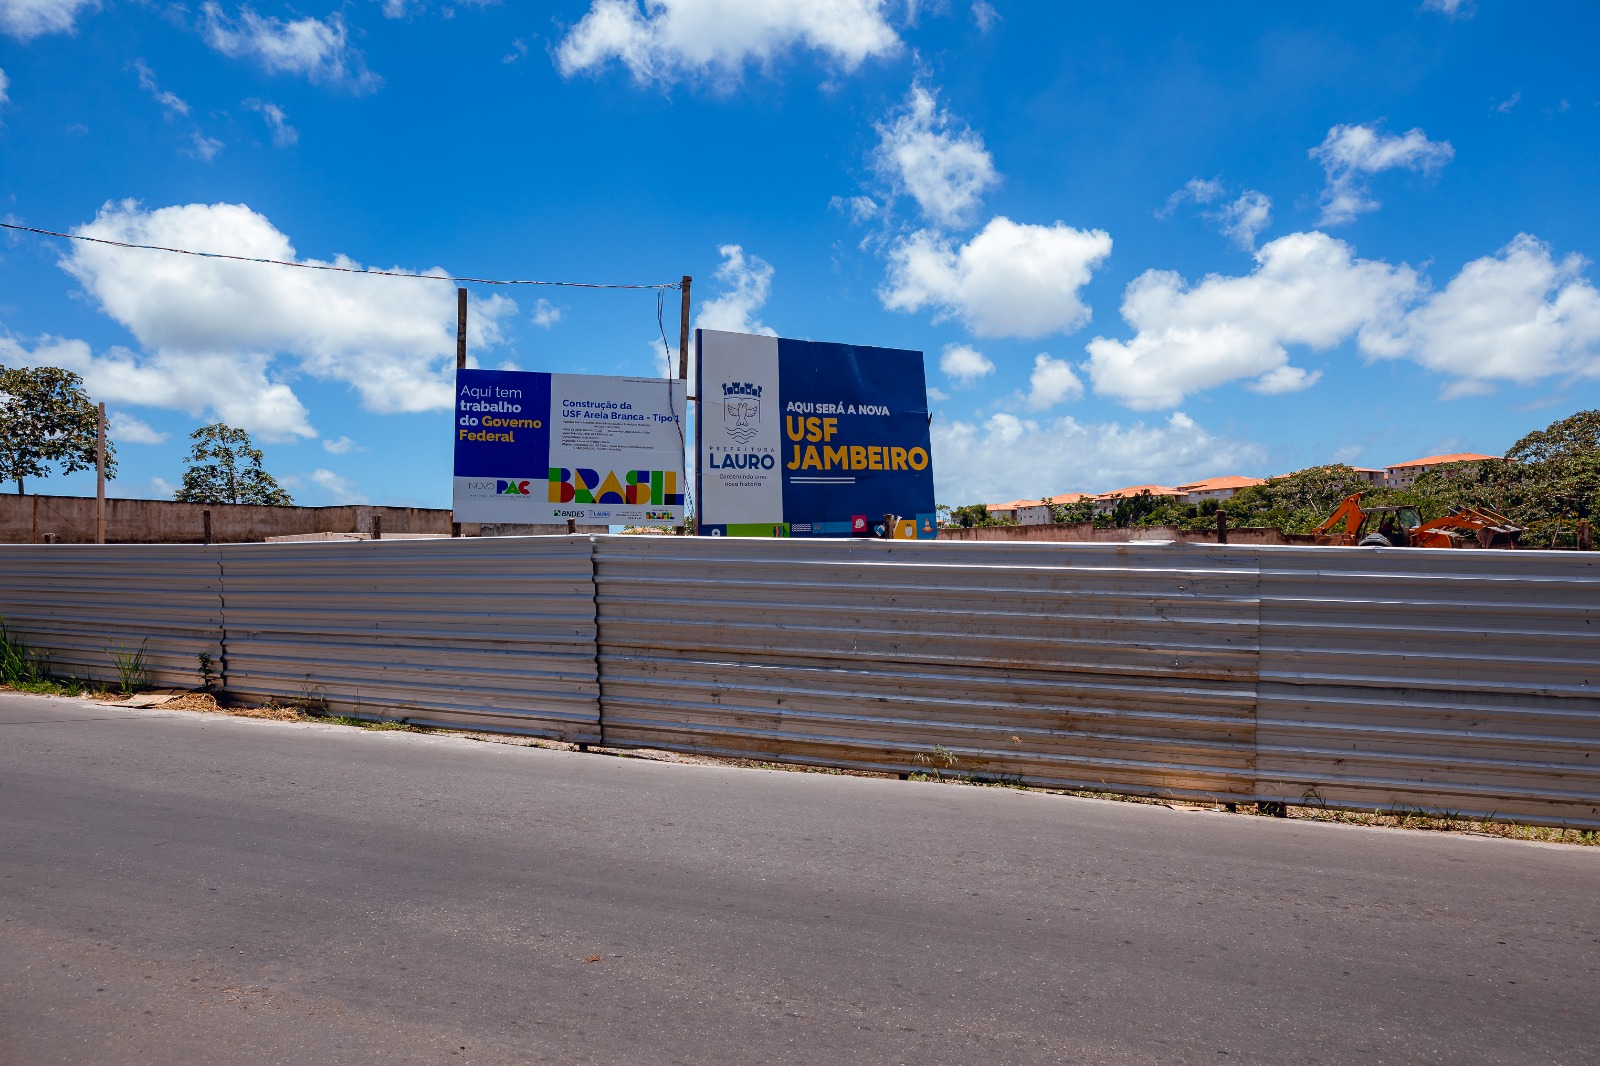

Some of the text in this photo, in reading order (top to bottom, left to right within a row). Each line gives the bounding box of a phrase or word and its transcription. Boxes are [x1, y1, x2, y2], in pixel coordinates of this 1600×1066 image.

[460, 385, 522, 399] Aqui tem
[460, 400, 522, 413] trabalho
[562, 399, 632, 410] Construção da
[786, 401, 890, 416] AQUI SERÁ A NOVA
[459, 415, 542, 429] do Governo
[562, 410, 581, 419] USF
[583, 410, 609, 420] Areia
[611, 412, 644, 421] Branca
[652, 414, 673, 424] Tipo
[459, 429, 515, 443] Federal
[786, 416, 838, 443] USF
[709, 452, 775, 470] LAURO
[787, 445, 929, 471] JAMBEIRO
[468, 480, 531, 495] NOVO PAC
[547, 467, 684, 506] BRASIL
[561, 510, 585, 518] BNDES
